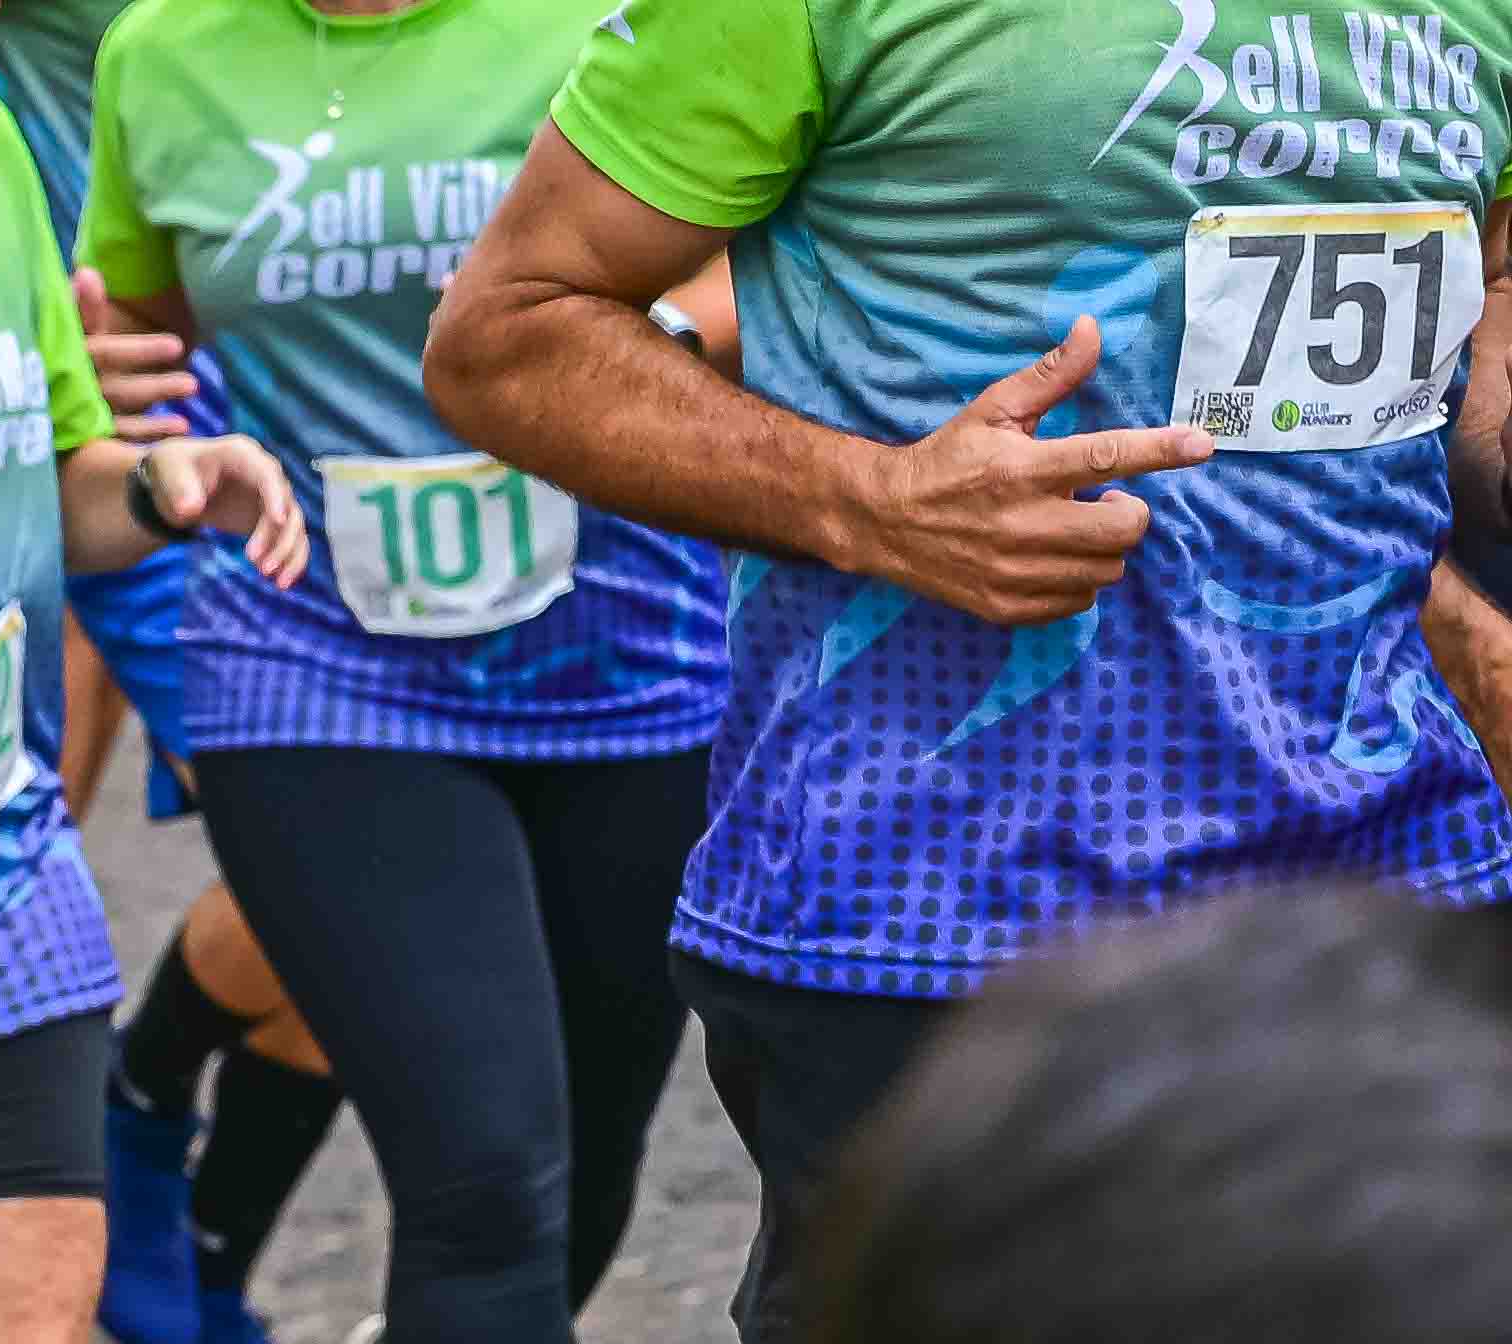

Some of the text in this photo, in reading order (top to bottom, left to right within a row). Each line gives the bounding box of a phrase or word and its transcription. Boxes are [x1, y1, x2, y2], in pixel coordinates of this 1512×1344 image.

[1343, 12, 1480, 113] Ville
[1171, 119, 1483, 184] corre
[258, 242, 474, 304] corr
[1229, 230, 1443, 386] 751
[359, 470, 534, 585] 101
